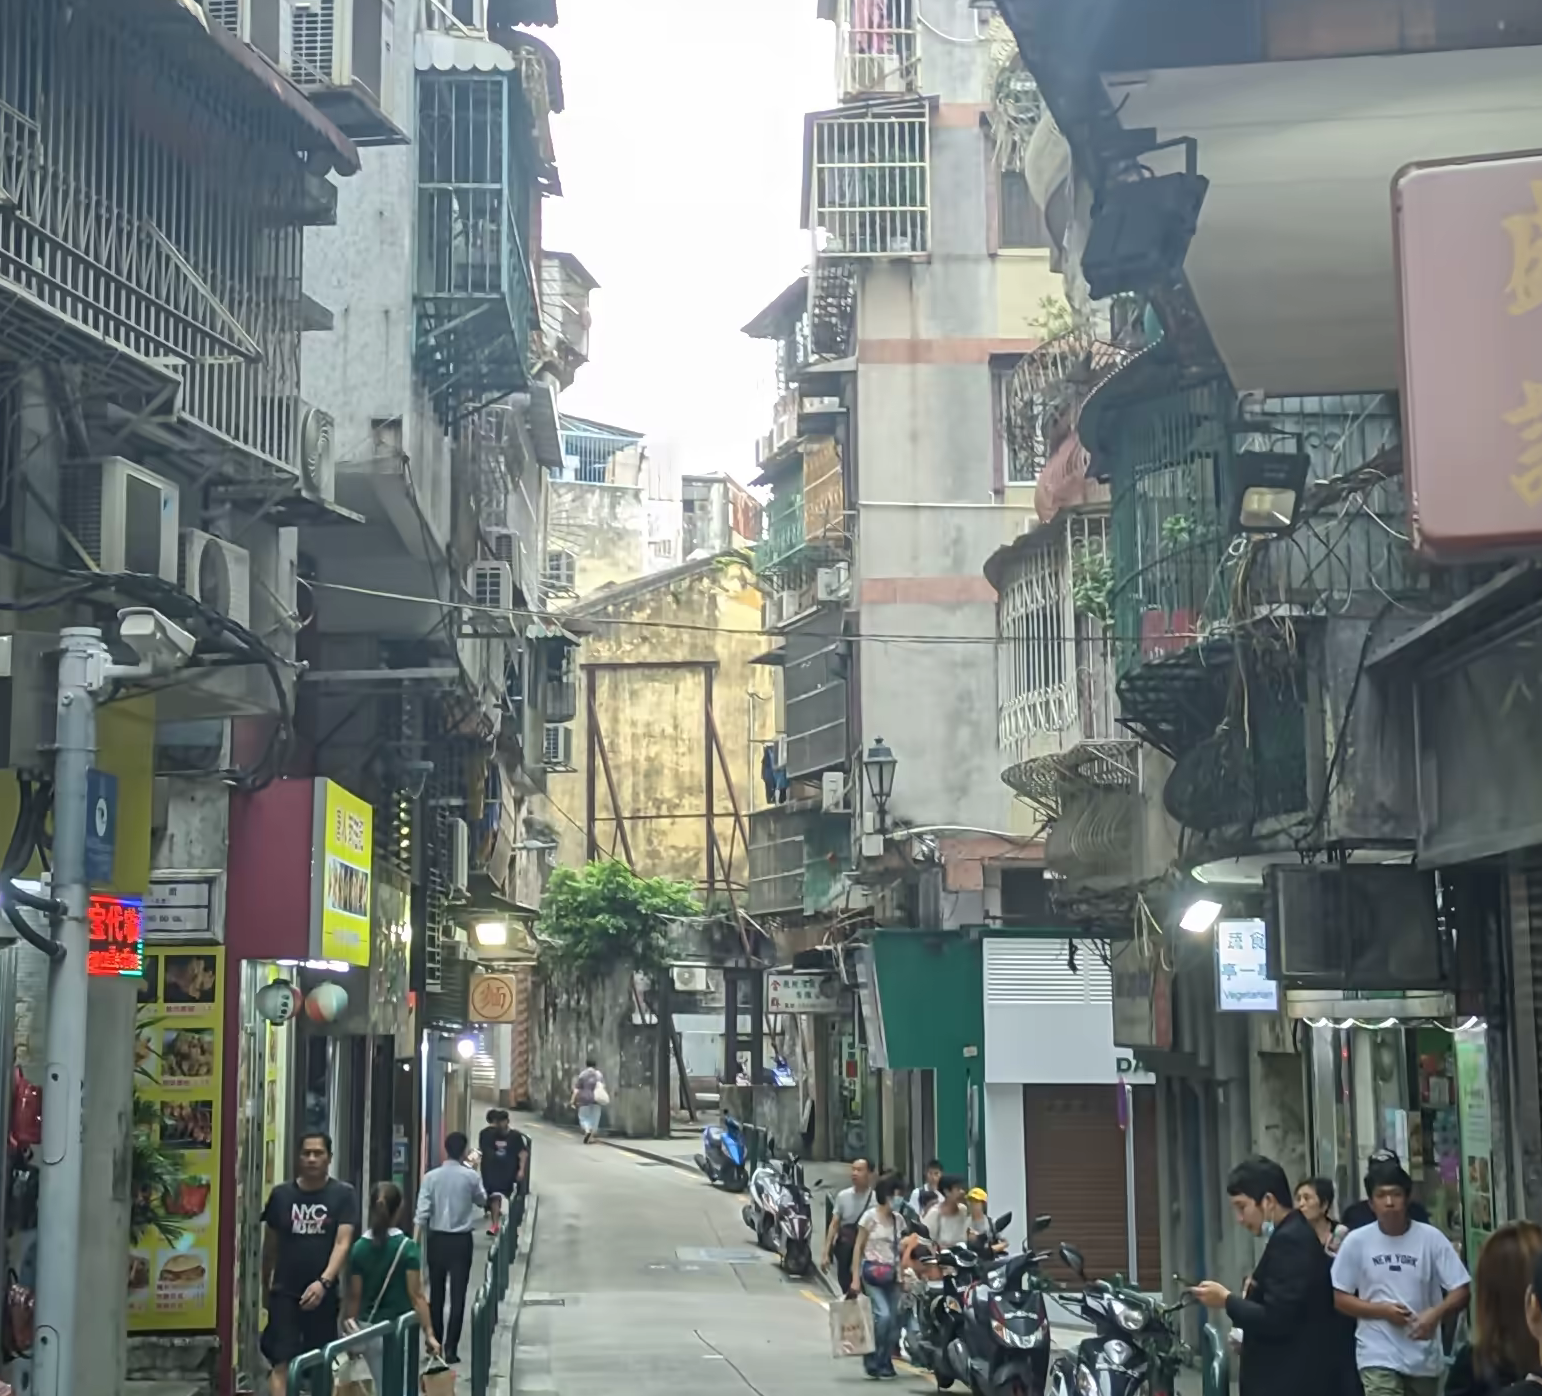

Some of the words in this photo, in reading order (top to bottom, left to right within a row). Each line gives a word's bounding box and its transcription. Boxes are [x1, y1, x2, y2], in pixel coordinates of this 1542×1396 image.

[291, 1202, 327, 1220] NYC
[1372, 1254, 1393, 1267] NEW
[1394, 1253, 1418, 1268] YORK
